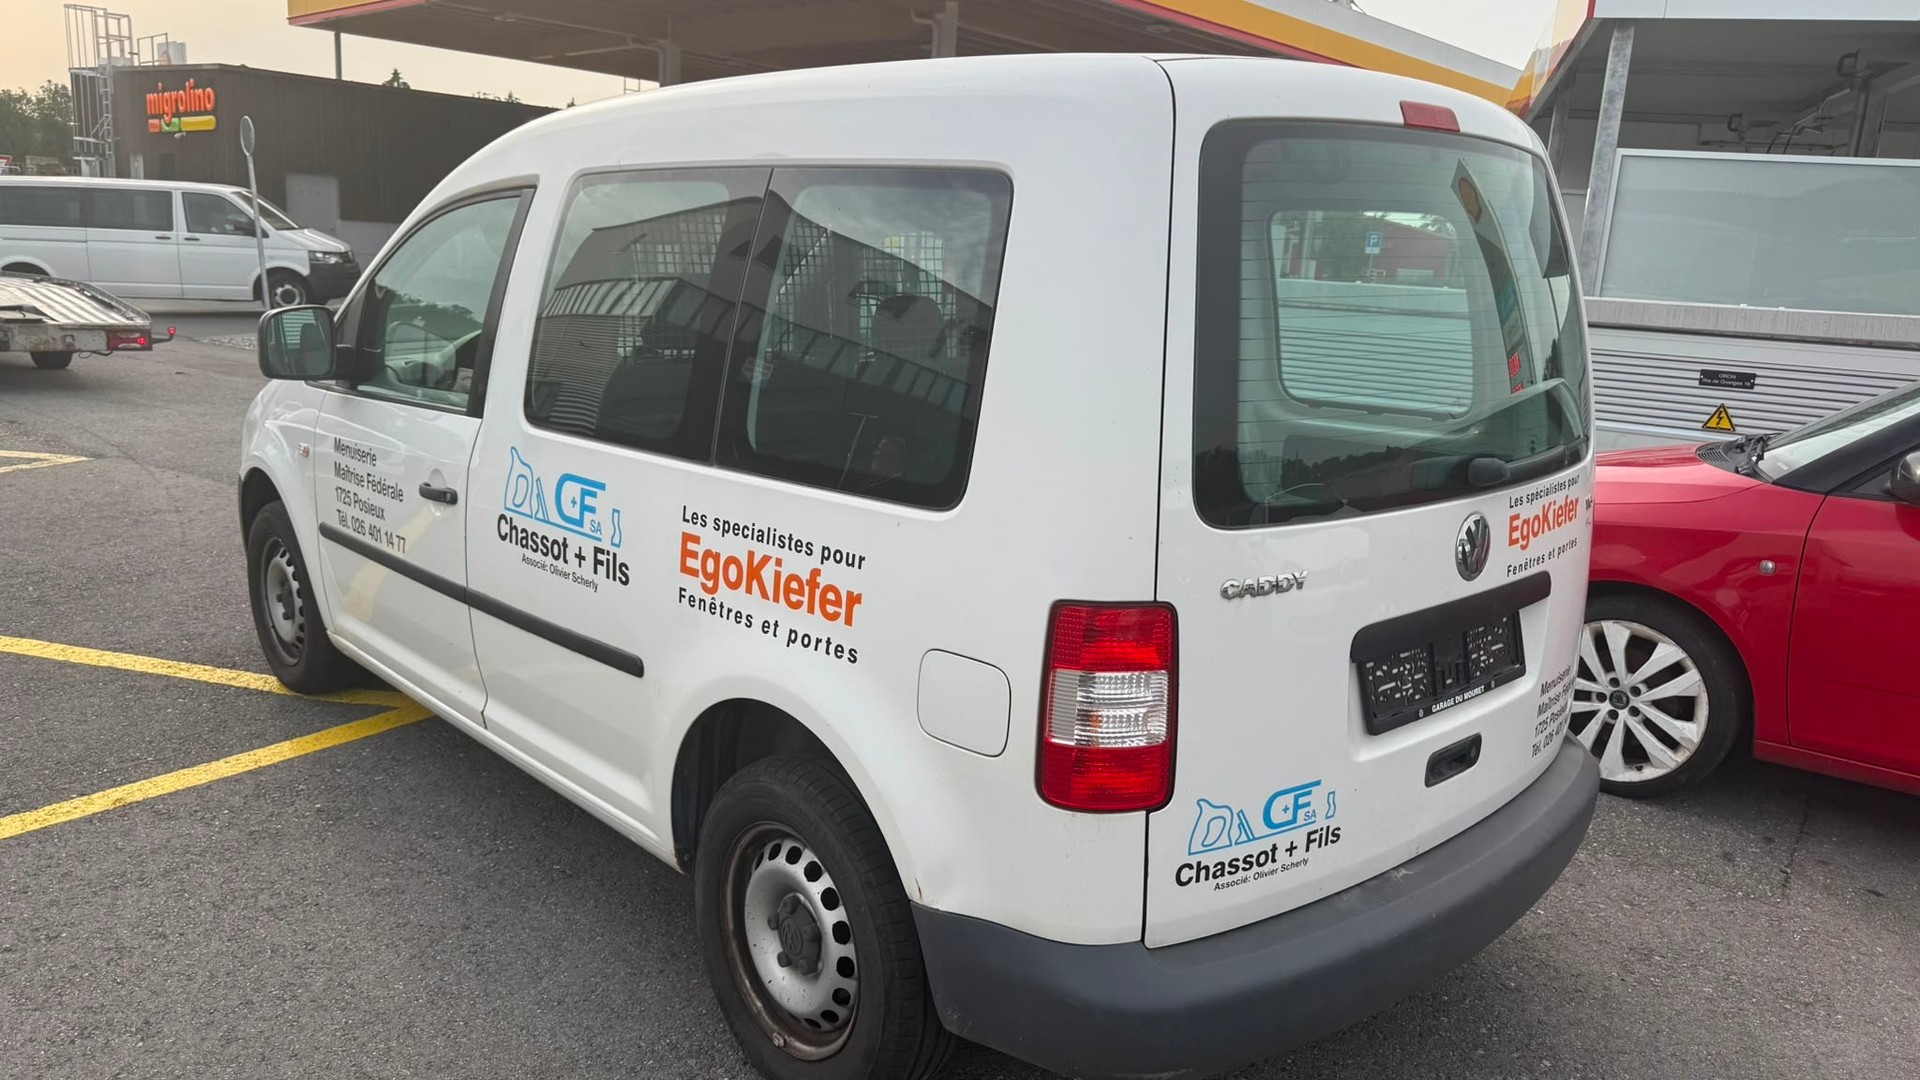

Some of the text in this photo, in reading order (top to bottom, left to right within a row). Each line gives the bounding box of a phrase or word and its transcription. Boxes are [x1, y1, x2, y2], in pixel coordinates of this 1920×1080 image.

[146, 78, 216, 124] migrolino
[334, 437, 376, 467] Menuiserie
[334, 461, 404, 502] Maîtrise Fédérale
[1509, 496, 1524, 509] Les
[1526, 480, 1566, 506] spécialistes
[1568, 474, 1580, 491] pour
[335, 486, 386, 520] 1725 Posieux
[1508, 494, 1580, 550] EgoKiefer
[351, 516, 366, 536] 026
[368, 524, 382, 544] 401
[384, 530, 394, 549] 14
[396, 534, 406, 554] 77
[590, 520, 602, 535] SA
[682, 505, 866, 570] Les specialistes pour
[497, 514, 568, 564] Chassot
[593, 546, 630, 586] Fils
[1506, 538, 1578, 577] Fenêtres et portes
[522, 553, 598, 593] Associé: Olivier Scherly
[680, 531, 862, 627] EgoKiefer
[1220, 570, 1309, 600] CADDY
[678, 586, 858, 664] Fenêtres et portes
[1432, 698, 1454, 712] GARAGE
[1456, 694, 1463, 703] DU
[1303, 809, 1317, 822] SA
[1175, 843, 1278, 887] Chassot
[1305, 825, 1342, 853] Fils
[1214, 857, 1309, 891] Associé: Olivier Scherly
